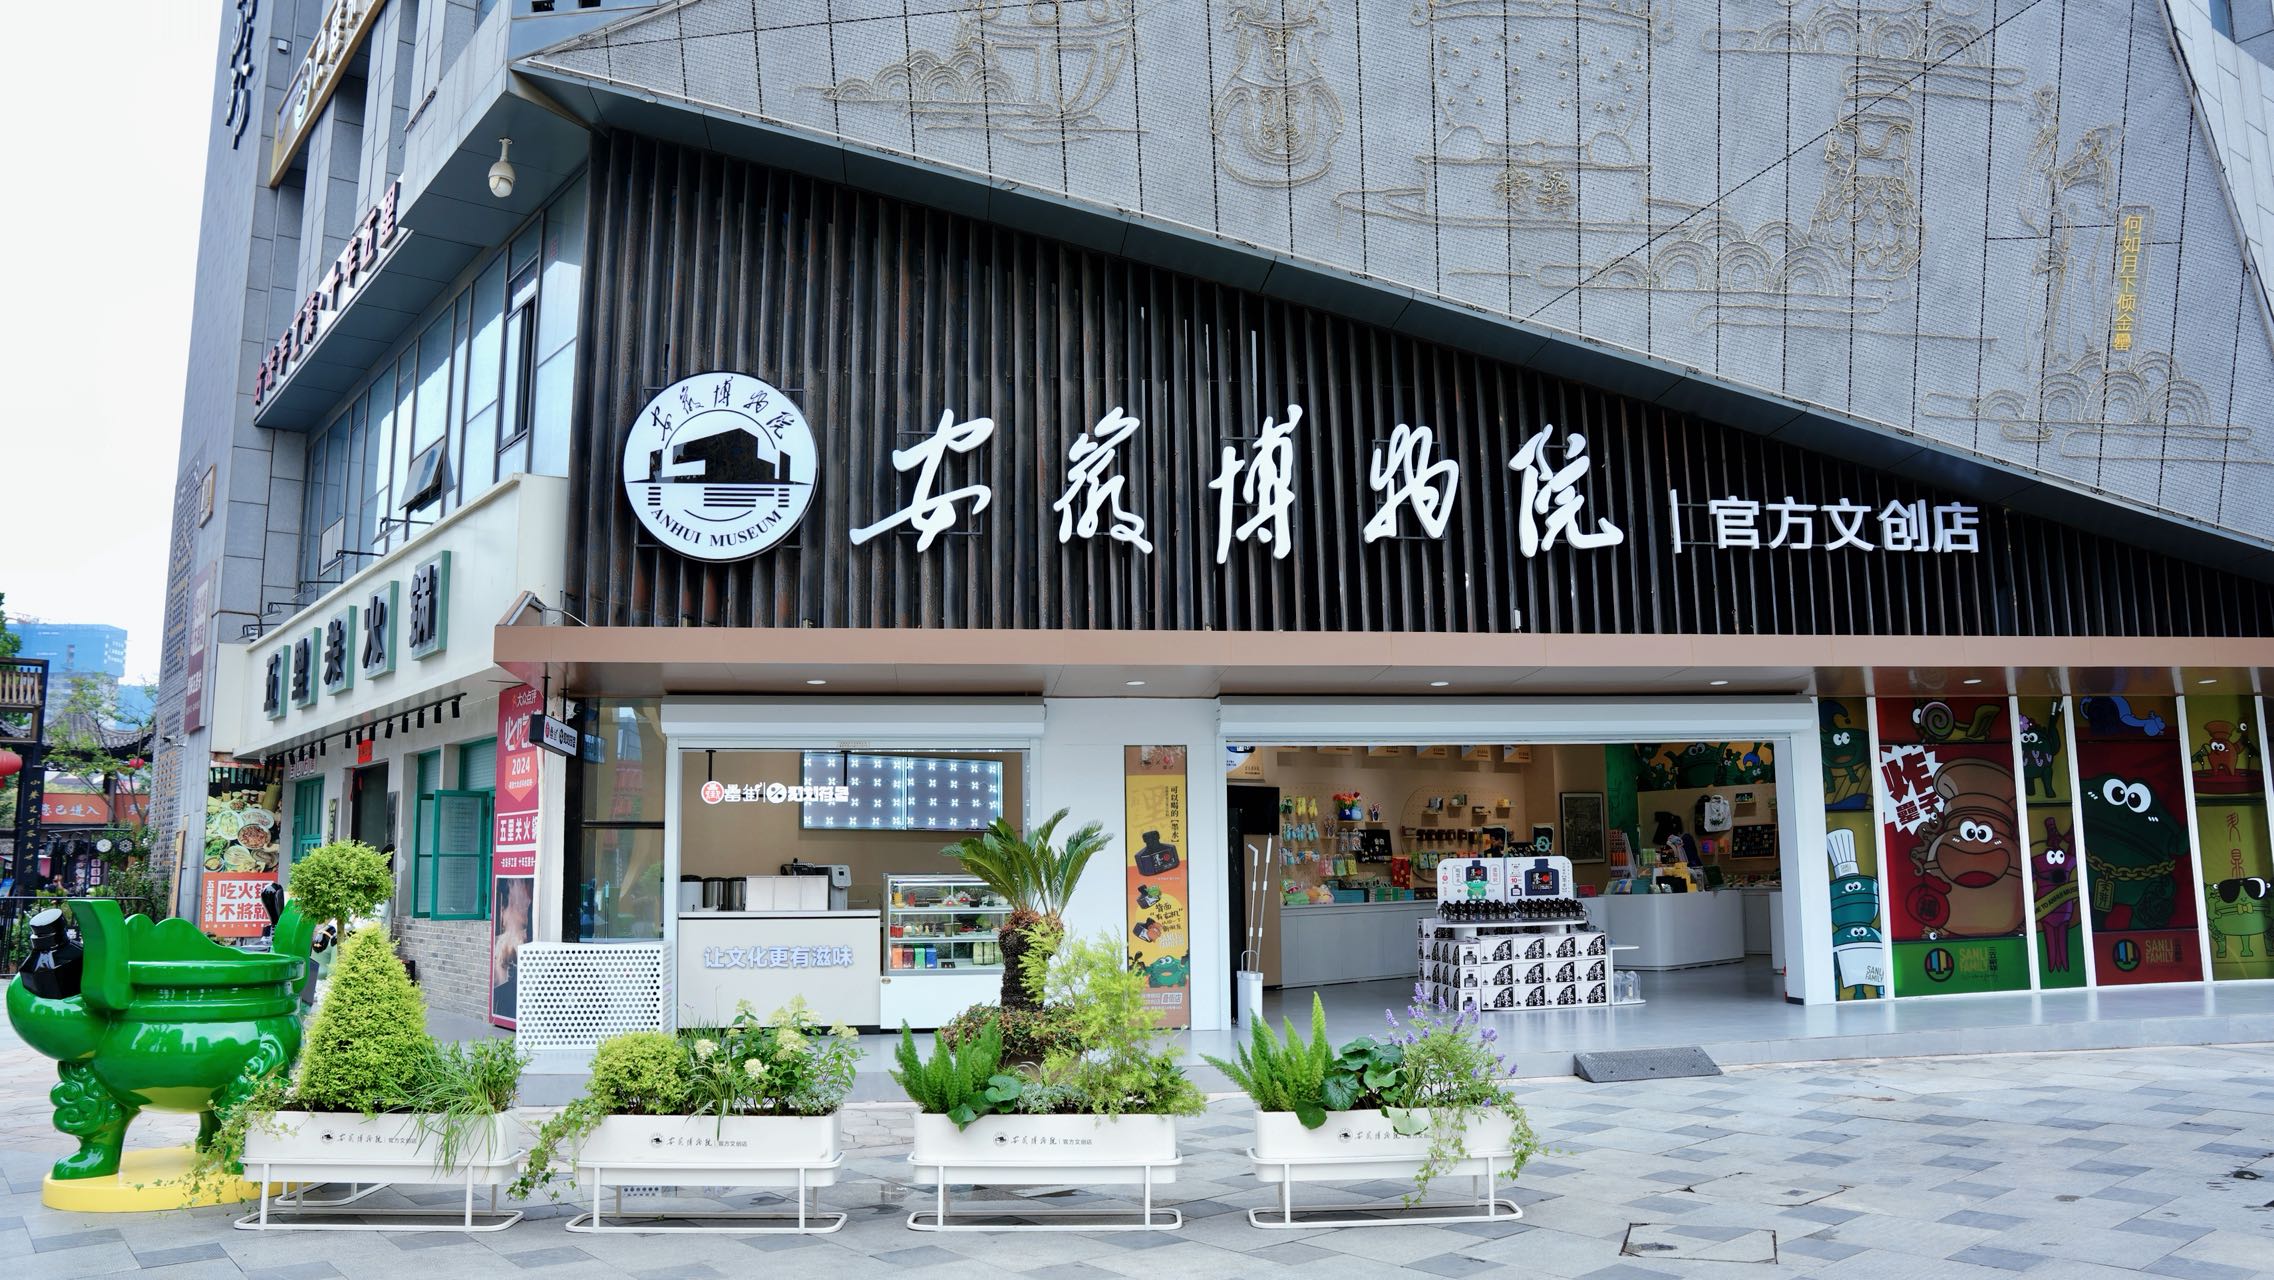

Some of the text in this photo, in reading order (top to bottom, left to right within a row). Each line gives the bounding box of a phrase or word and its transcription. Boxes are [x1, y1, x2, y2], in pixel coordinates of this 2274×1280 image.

[651, 376, 795, 441] 安徽博物院
[849, 404, 1624, 564] 安徽博物院
[651, 507, 783, 547] ANHUI MUSEUM
[1708, 496, 1980, 553] 官方文创店
[263, 563, 436, 713] 五里关火锅
[511, 756, 531, 776] 2024
[704, 945, 853, 968] 让文化更有滋味
[2145, 939, 2173, 951] SANLI
[1866, 965, 1885, 978] SANLI
